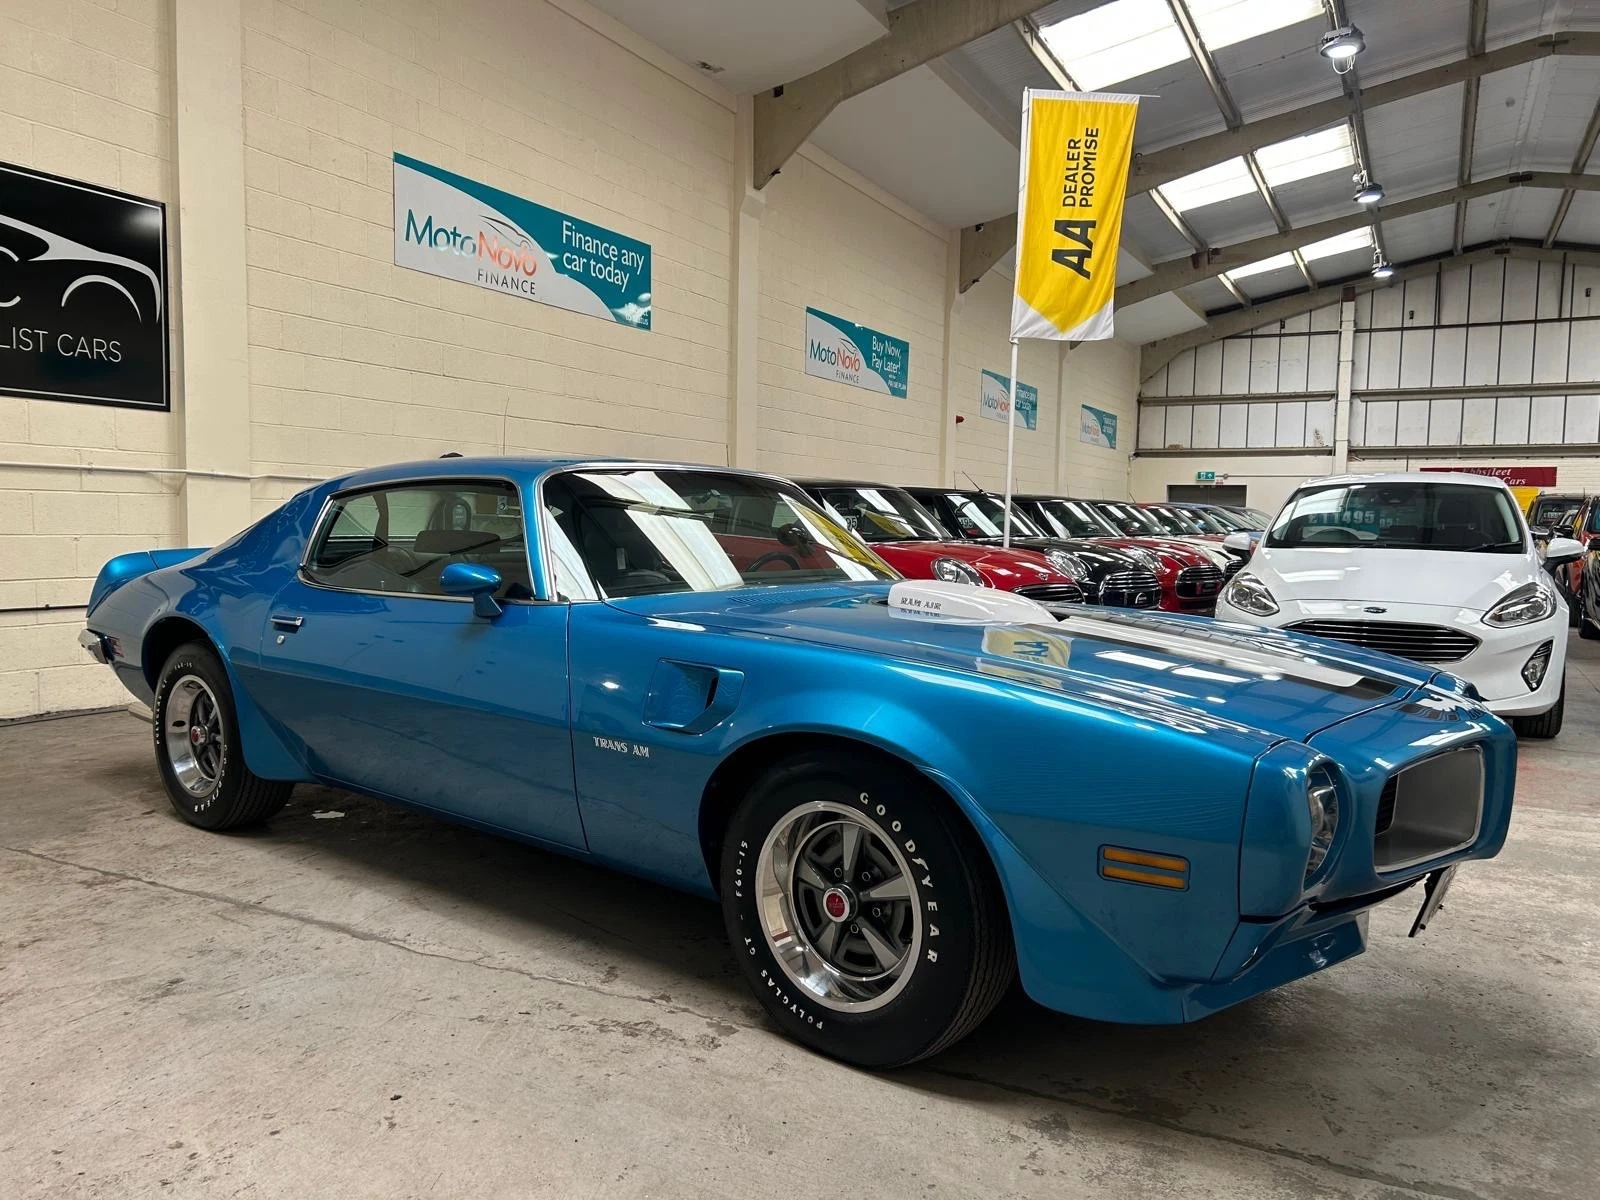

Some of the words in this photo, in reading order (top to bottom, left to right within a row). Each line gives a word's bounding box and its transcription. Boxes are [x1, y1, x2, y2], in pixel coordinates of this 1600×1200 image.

[1062, 138, 1082, 208] DEALER
[1079, 127, 1099, 208] PROMISE
[404, 208, 537, 277] MotoNovo
[562, 220, 618, 262] Finance
[621, 248, 645, 275] any
[1051, 219, 1097, 280] AA
[477, 267, 537, 296] FINANCE
[562, 252, 587, 273] car
[590, 261, 630, 292] today
[57, 333, 122, 363] CARS
[809, 338, 860, 373] MotoNovo
[872, 335, 884, 355] Buy
[836, 370, 860, 384] FINANCE
[872, 353, 882, 373] Pay
[900, 596, 922, 607] RAM
[924, 601, 942, 610] AIR
[593, 736, 628, 753] TRANS
[632, 744, 650, 758] AM
[859, 792, 940, 964] GOODYEAR
